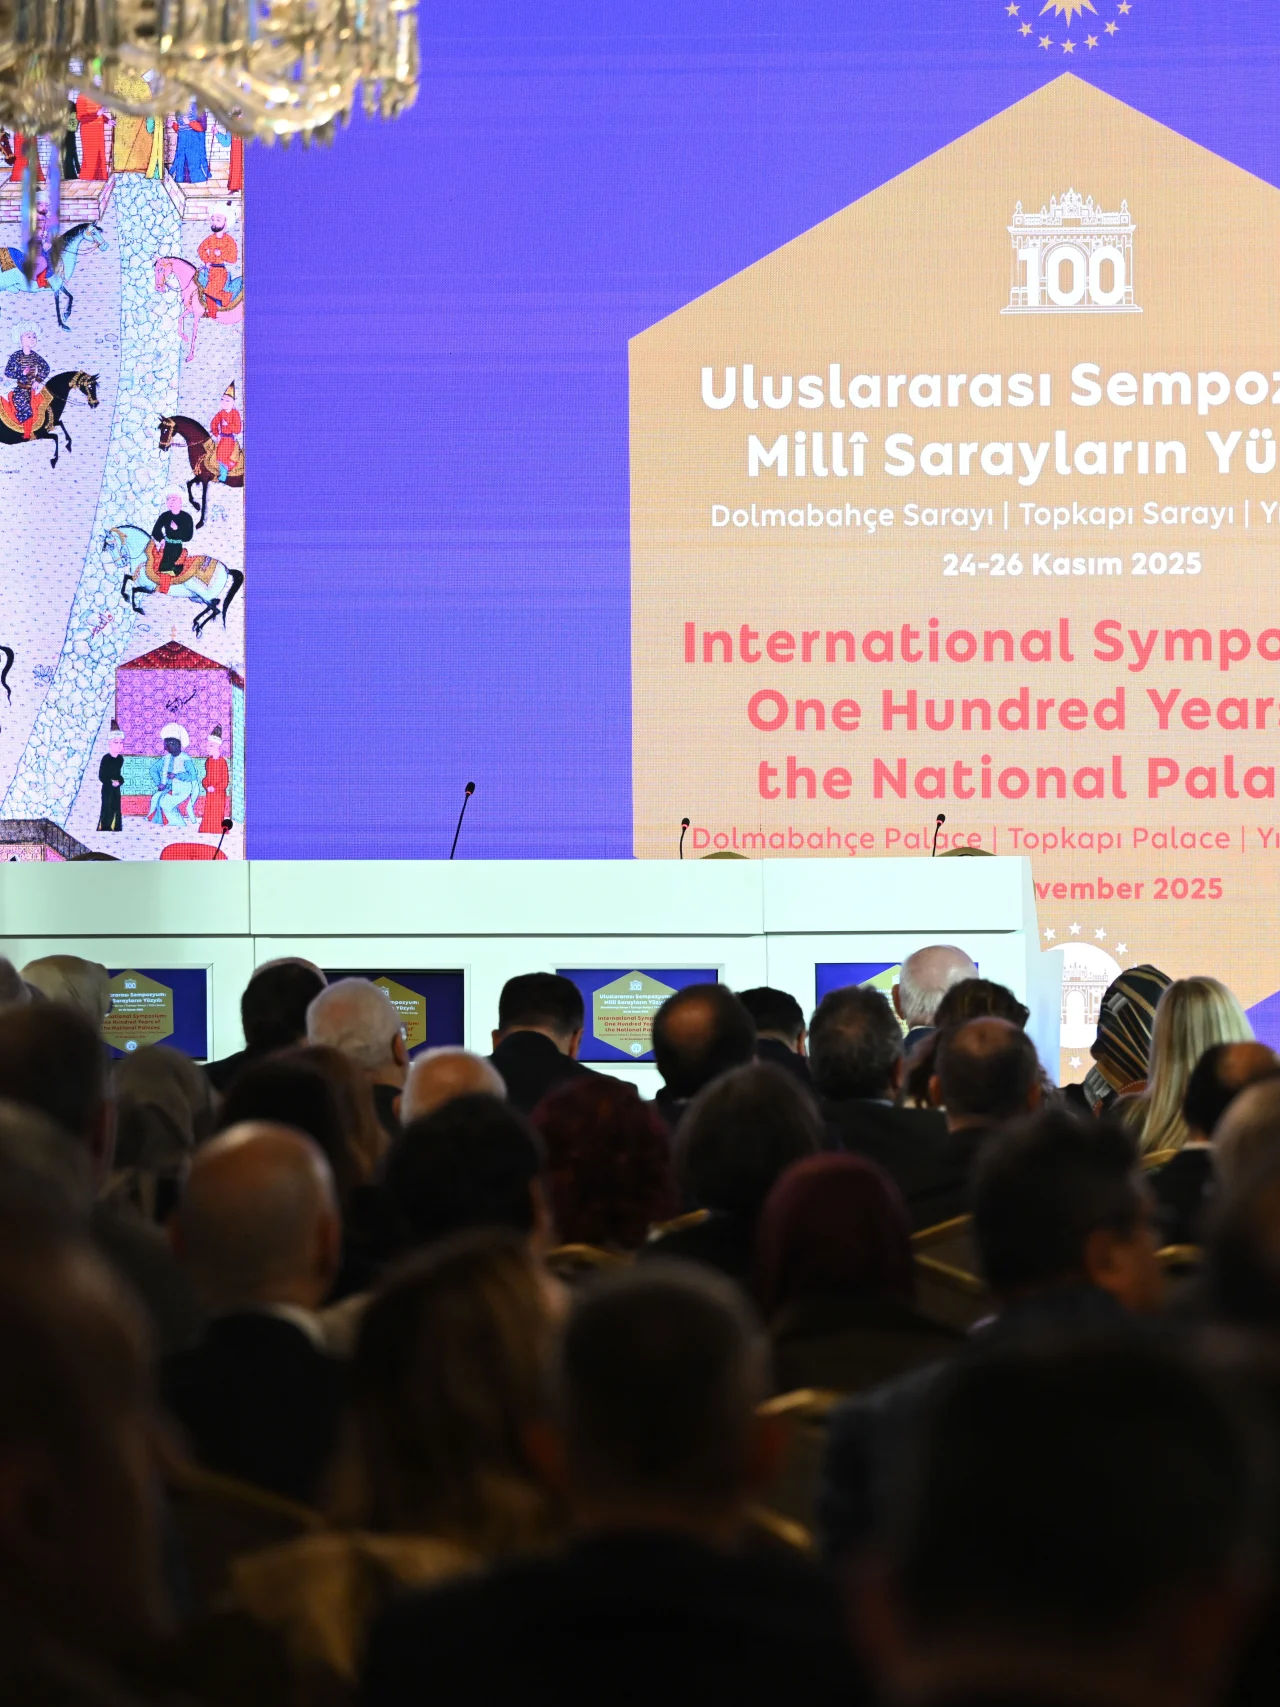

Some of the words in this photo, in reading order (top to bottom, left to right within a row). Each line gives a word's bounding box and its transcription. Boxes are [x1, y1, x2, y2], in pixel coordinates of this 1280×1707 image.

[1019, 245, 1125, 306] 100
[702, 364, 1051, 409] Uluslararası
[748, 431, 868, 477] Millî
[885, 430, 1187, 485] Sarayların
[711, 503, 894, 534] Dolmabahçe
[903, 503, 993, 532] Sarayı
[1019, 501, 1134, 531] Topkapı
[1143, 501, 1234, 530] Sarayı
[942, 552, 1024, 577] 24-26
[1032, 552, 1123, 576] Kasım
[1131, 551, 1202, 576] 2025
[685, 617, 1074, 664] International
[747, 689, 862, 732] One
[882, 686, 1125, 731] Hundred
[758, 755, 853, 800] the
[873, 754, 1127, 800] National
[692, 826, 875, 857] Dolmabahçe
[885, 826, 982, 850] Palace
[1008, 826, 1122, 854] Topkapı
[1132, 826, 1231, 850] Palace
[1035, 876, 1145, 900] vember
[1153, 877, 1224, 900] 2025
